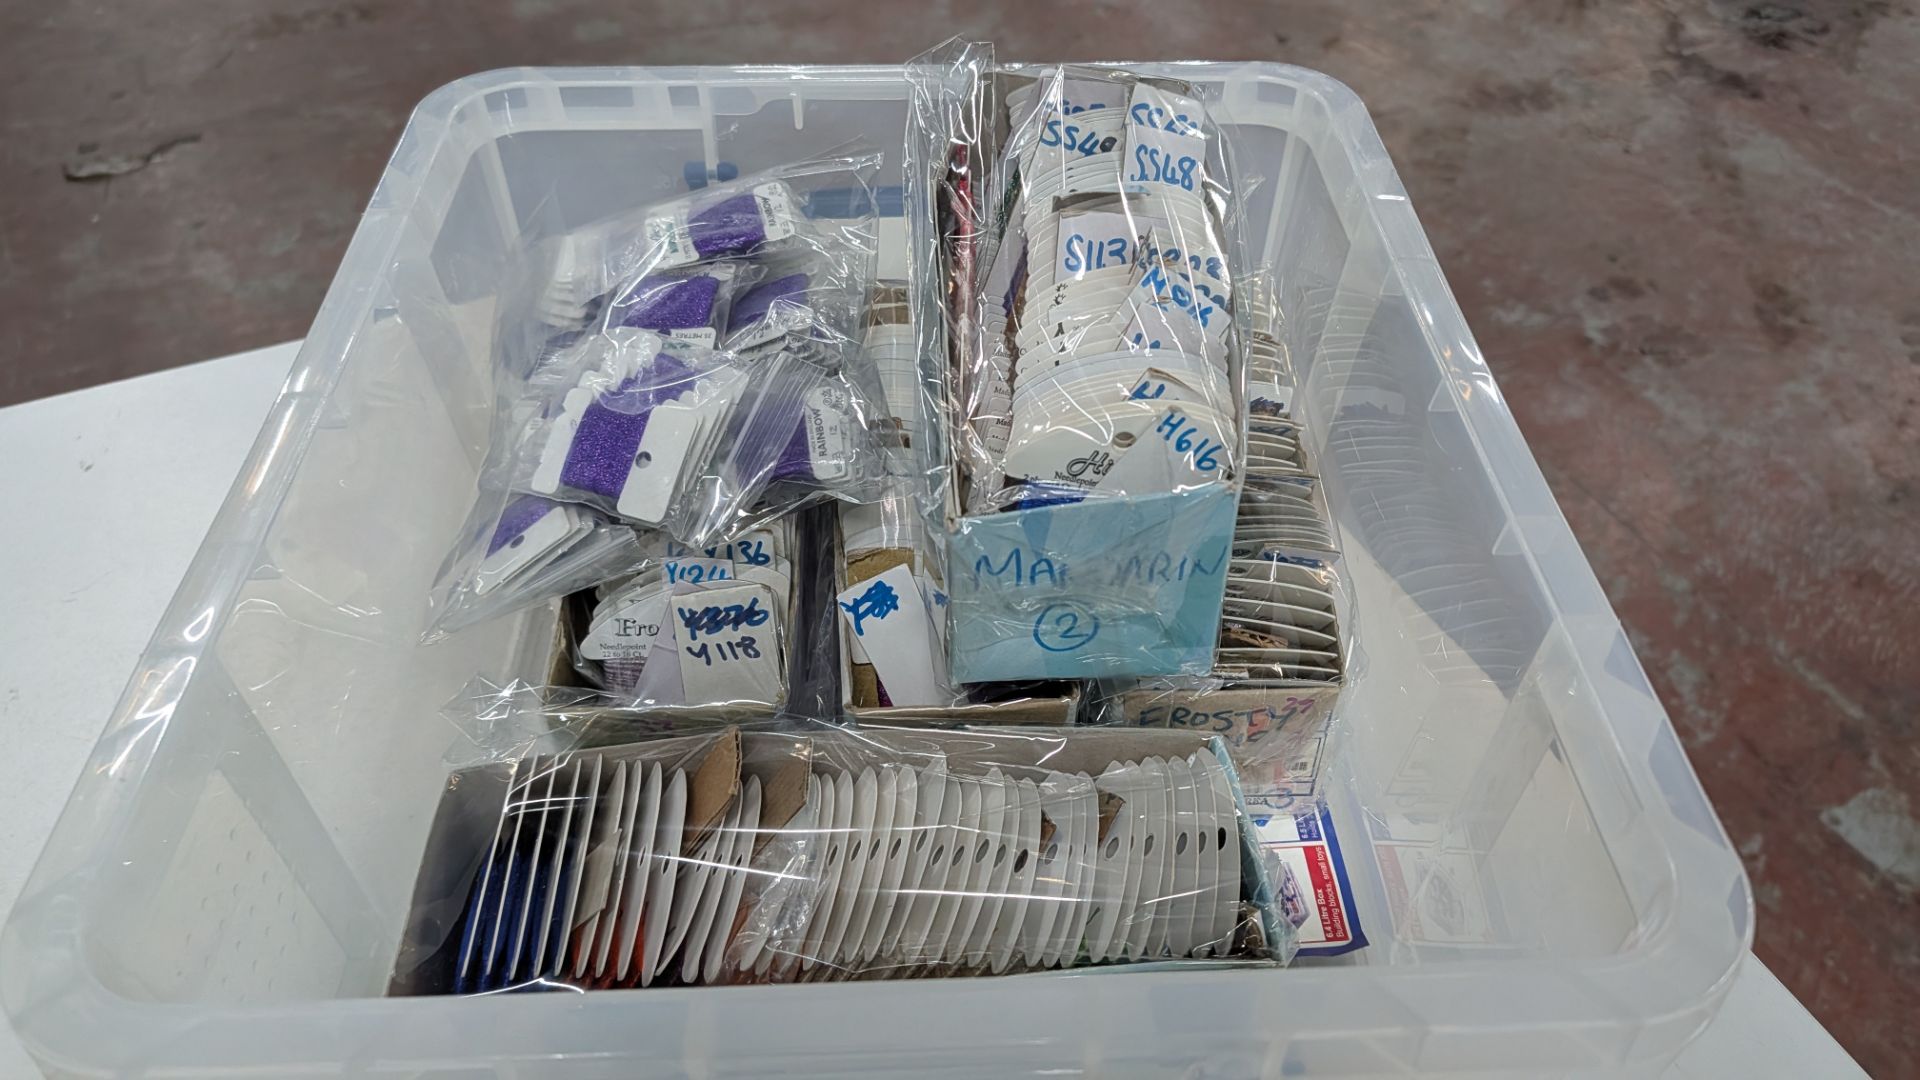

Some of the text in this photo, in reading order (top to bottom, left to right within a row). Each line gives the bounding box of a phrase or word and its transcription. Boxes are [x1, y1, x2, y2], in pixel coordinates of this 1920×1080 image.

[1130, 143, 1197, 192] SS48
[811, 408, 828, 457] RAINBOW
[1156, 412, 1223, 471] H616
[599, 643, 647, 652] Needlepoint
[1138, 705, 1298, 733] FROSTY
[1315, 846, 1325, 861] toys
[1318, 862, 1330, 880] small
[1316, 888, 1334, 938] 6.4 Litre Box
[1332, 908, 1345, 938] Building
